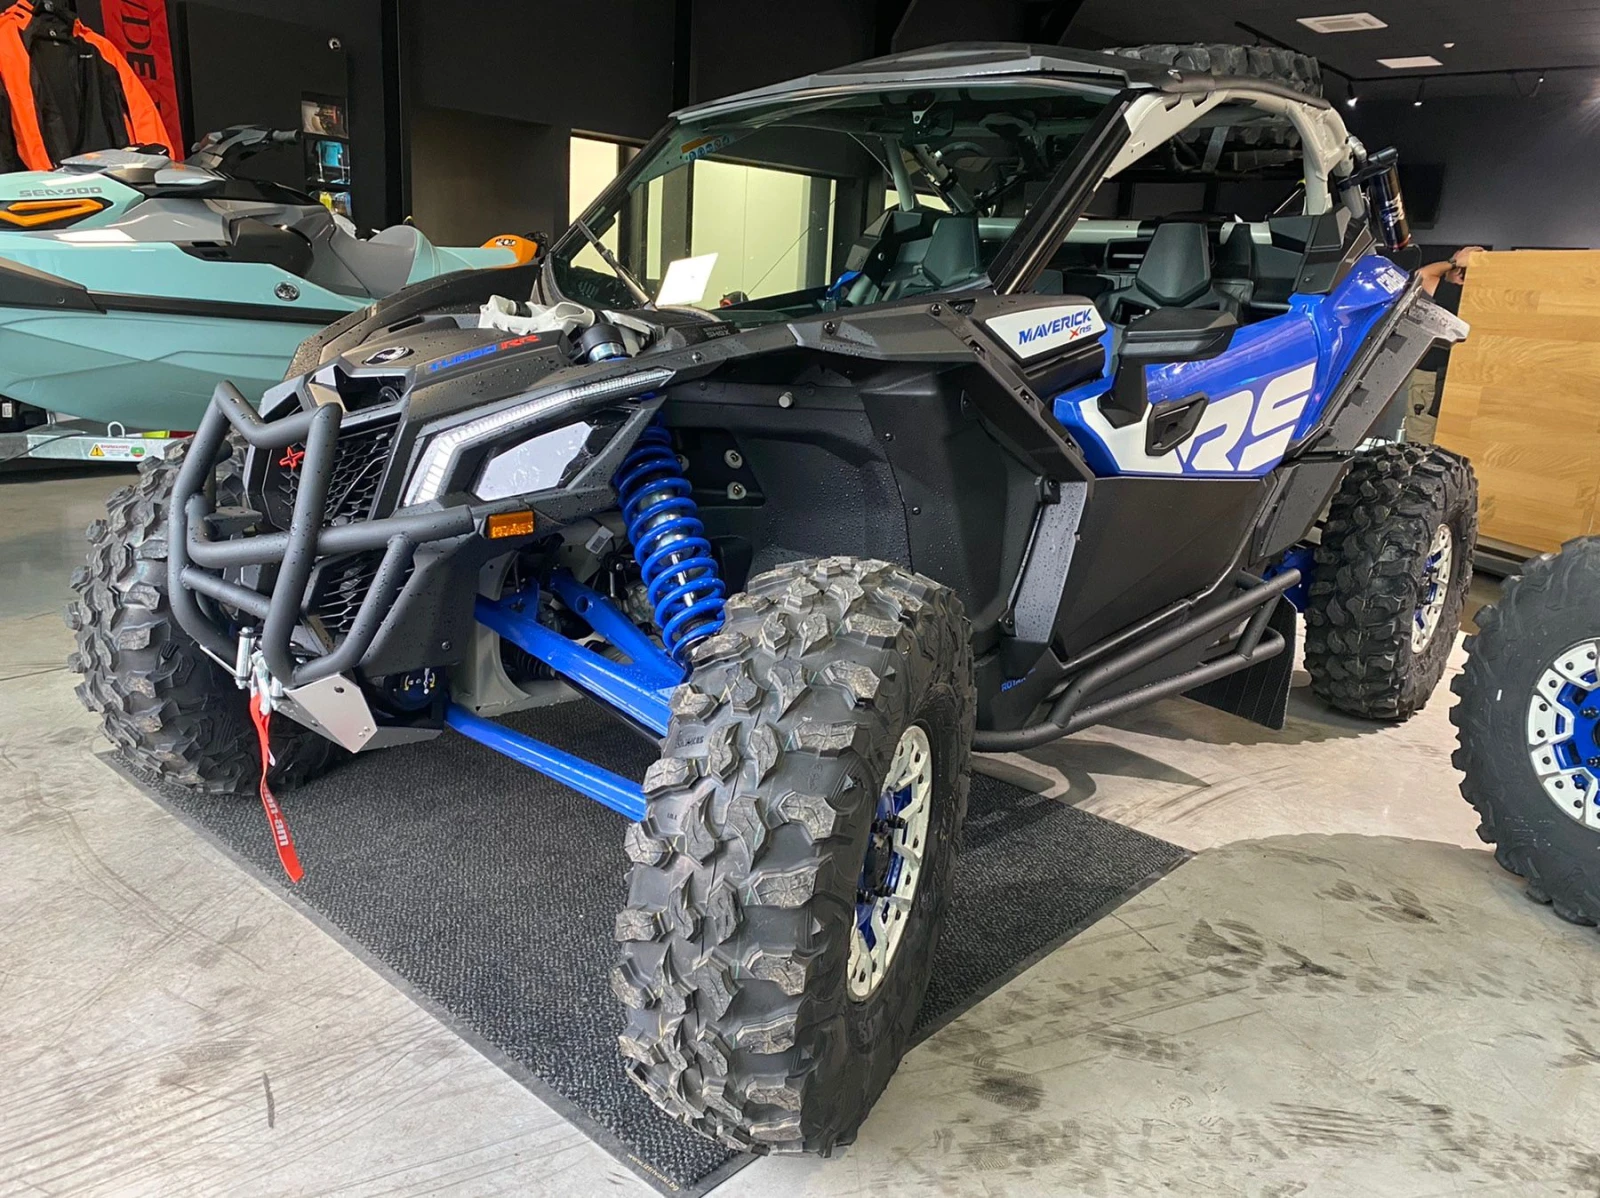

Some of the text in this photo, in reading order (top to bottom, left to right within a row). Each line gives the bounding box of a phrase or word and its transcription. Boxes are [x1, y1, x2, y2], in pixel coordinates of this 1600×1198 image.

[1018, 308, 1092, 345] MAVERICK
[427, 334, 540, 373] TURBO RR
